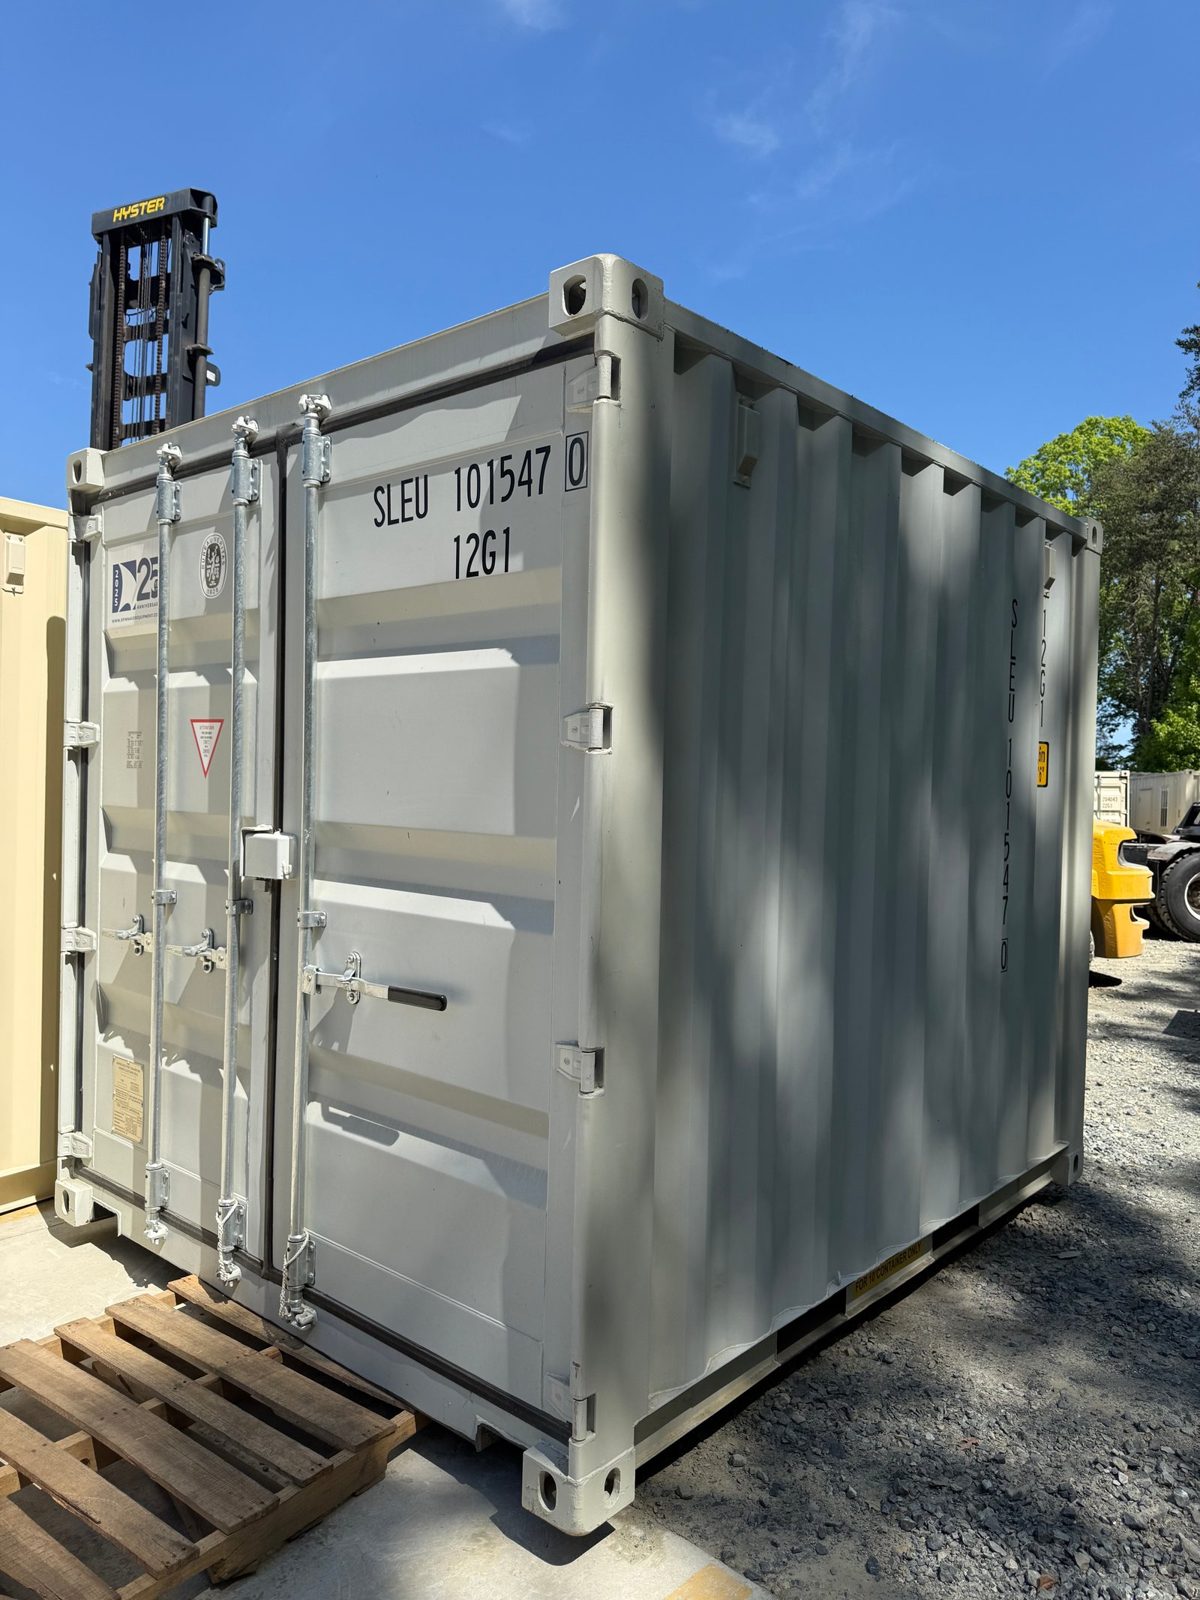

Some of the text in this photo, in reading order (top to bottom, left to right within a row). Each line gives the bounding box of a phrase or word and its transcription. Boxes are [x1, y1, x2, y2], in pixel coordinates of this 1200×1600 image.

[112, 196, 165, 222] HYSTER
[373, 437, 585, 527] SLEU 101547 0
[453, 526, 510, 579] 12G1
[1008, 598, 1018, 723] SLEU
[1003, 737, 1012, 925] 101547
